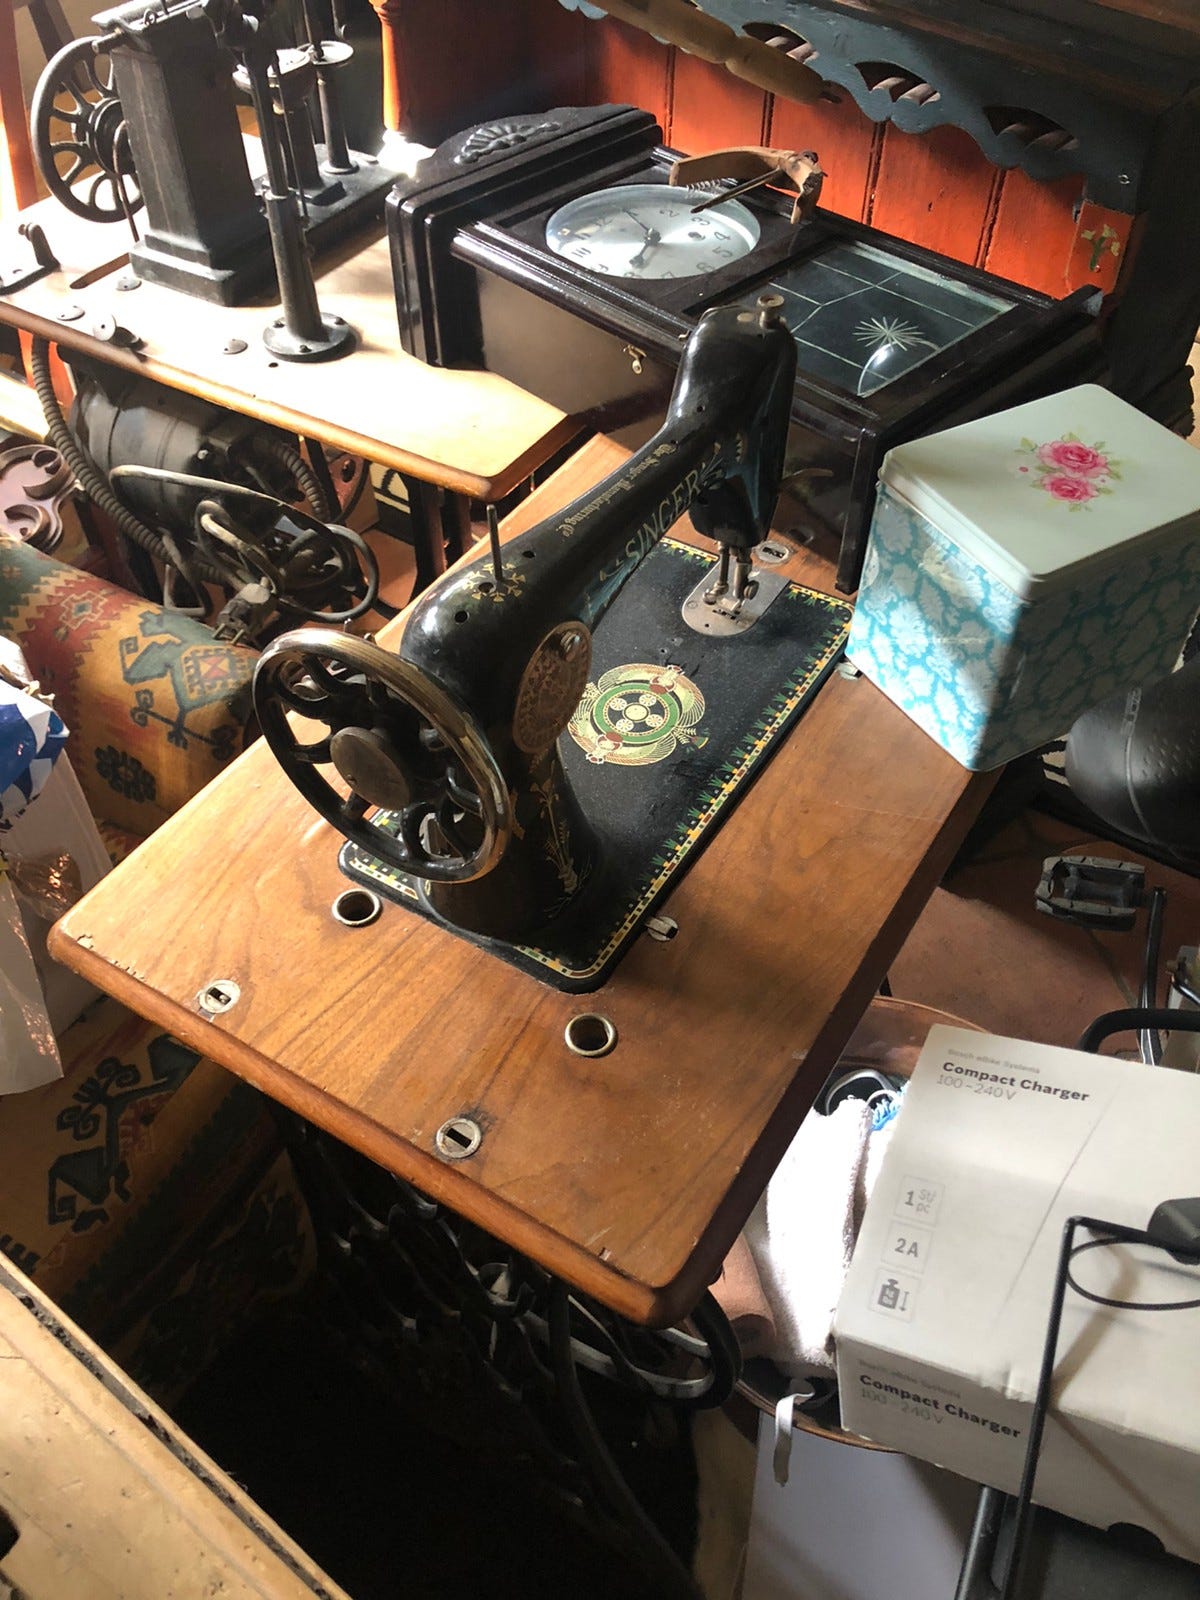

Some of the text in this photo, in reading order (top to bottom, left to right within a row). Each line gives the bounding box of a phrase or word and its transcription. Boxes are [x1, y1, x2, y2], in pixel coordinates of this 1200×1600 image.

[625, 469, 701, 559] SINGER
[942, 1061, 1090, 1102] Compact Charger
[905, 1189, 915, 1207] 1
[860, 1374, 940, 1409] Compact
[944, 1402, 1021, 1439] Charger
